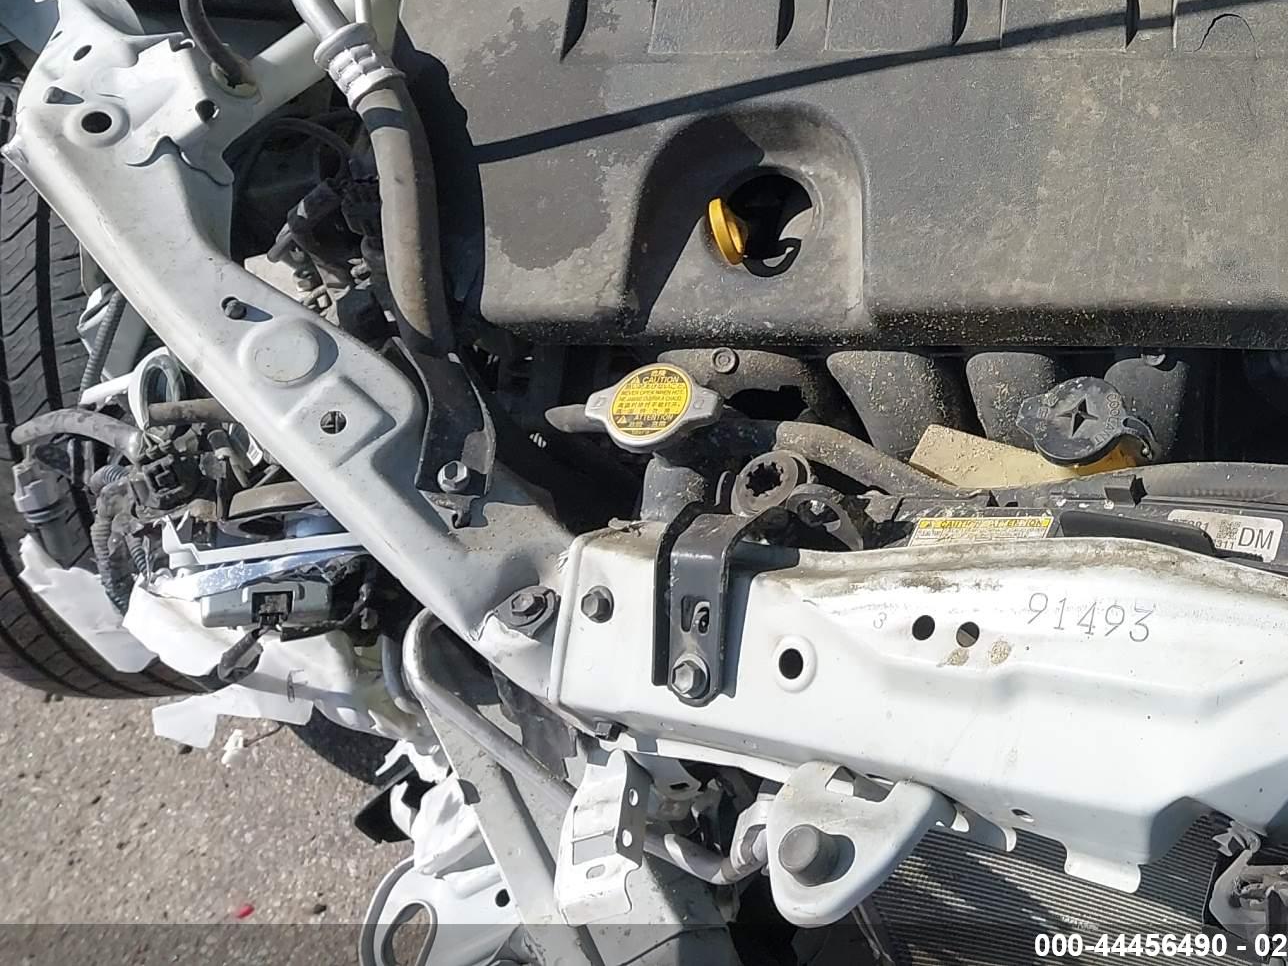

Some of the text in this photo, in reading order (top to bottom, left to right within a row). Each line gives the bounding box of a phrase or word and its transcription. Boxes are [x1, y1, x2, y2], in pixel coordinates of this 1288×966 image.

[642, 375, 680, 384] CAUTION
[1093, 393, 1121, 446] COOLANT
[1238, 527, 1275, 550] DM
[1027, 592, 1157, 643] 91493
